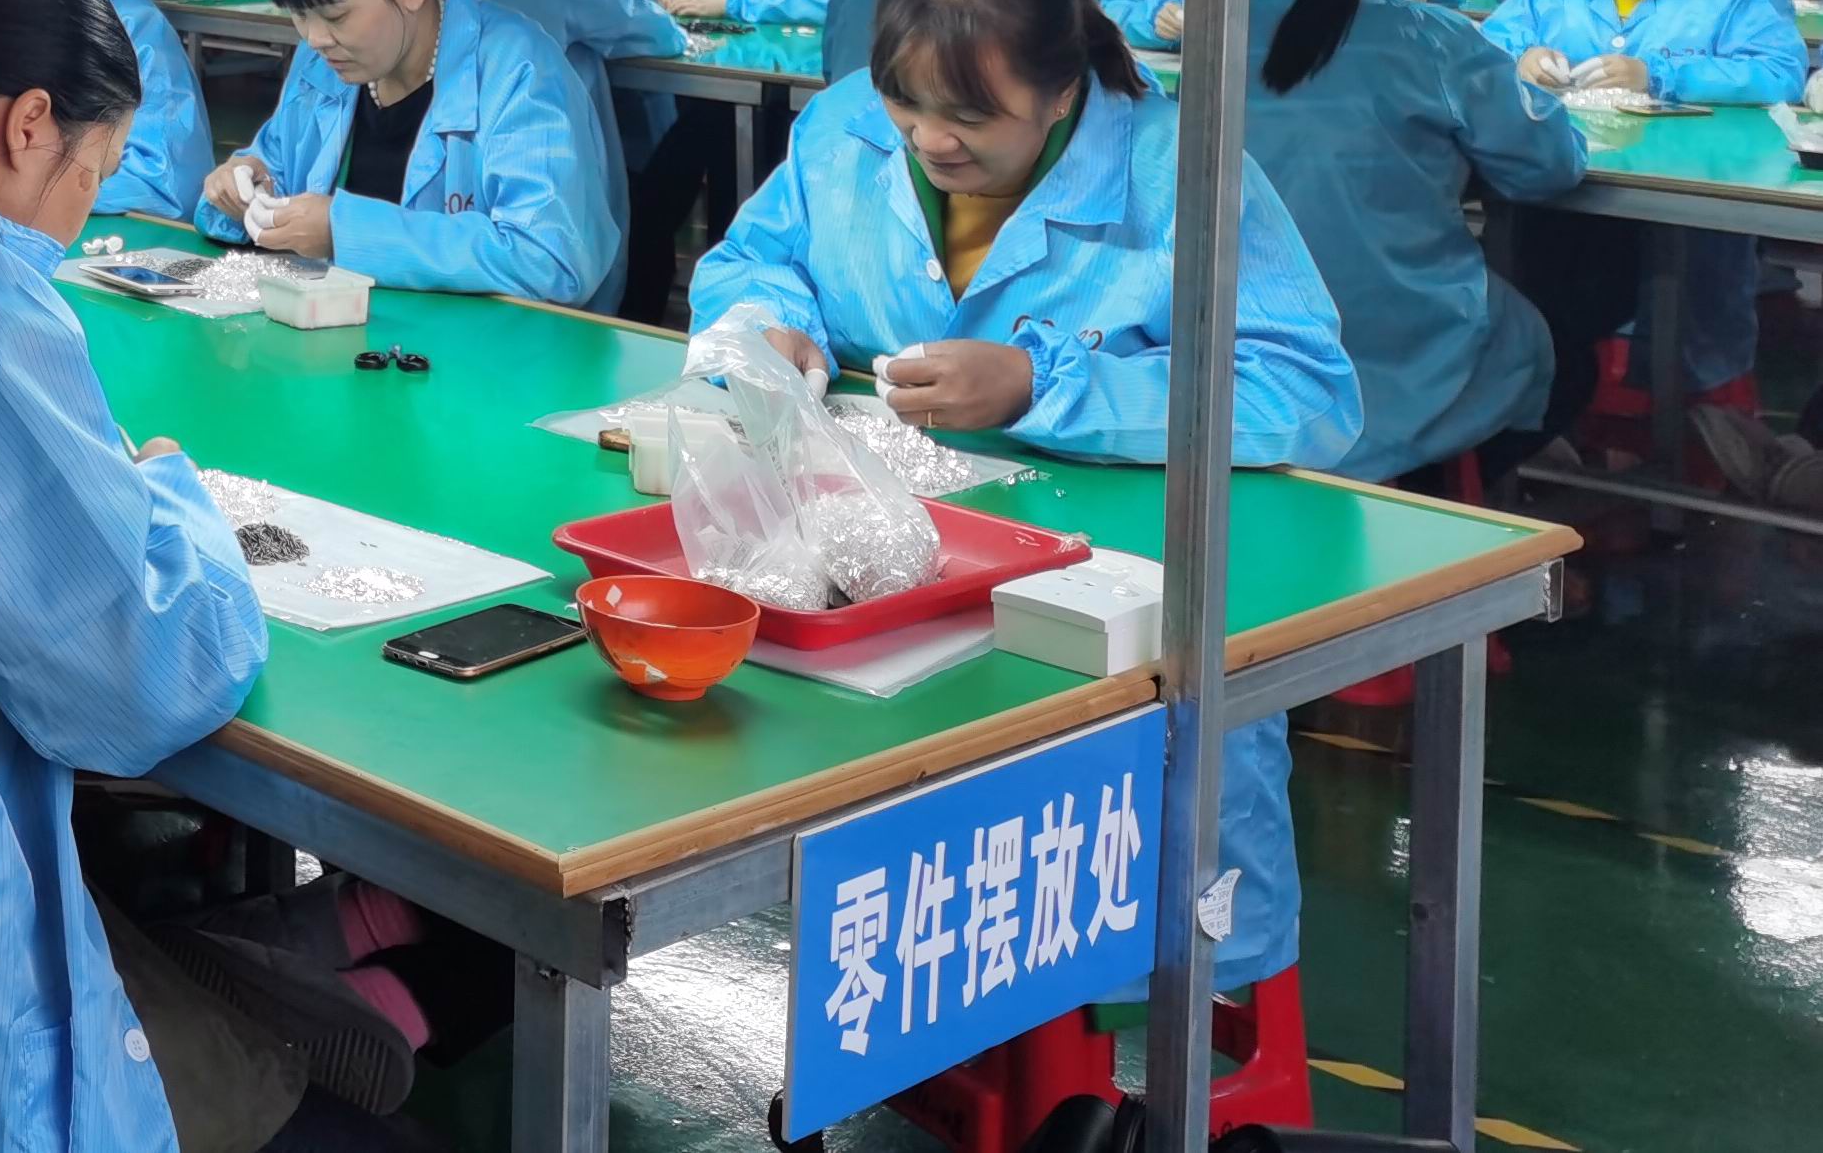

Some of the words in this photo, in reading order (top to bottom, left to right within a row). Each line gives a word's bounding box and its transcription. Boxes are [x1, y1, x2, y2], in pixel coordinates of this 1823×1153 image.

[825, 772, 1142, 1057] 零件摆放处
